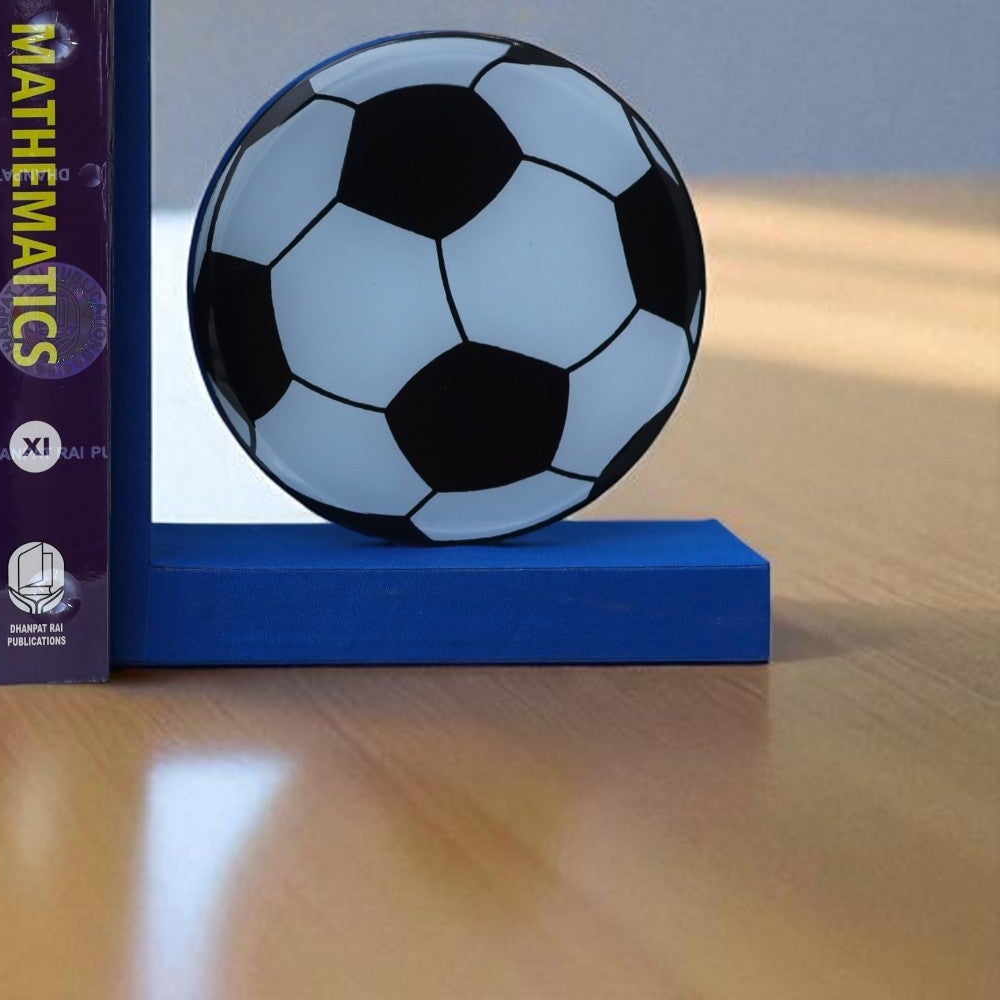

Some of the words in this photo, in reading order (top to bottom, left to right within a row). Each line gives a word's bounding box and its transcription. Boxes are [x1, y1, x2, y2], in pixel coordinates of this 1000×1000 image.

[11, 23, 58, 367] MATHEMATICS
[22, 437, 49, 457] XI
[10, 623, 48, 633] DHANPAT
[49, 622, 63, 632] RAI
[7, 635, 67, 647] PUBLICATIONS
